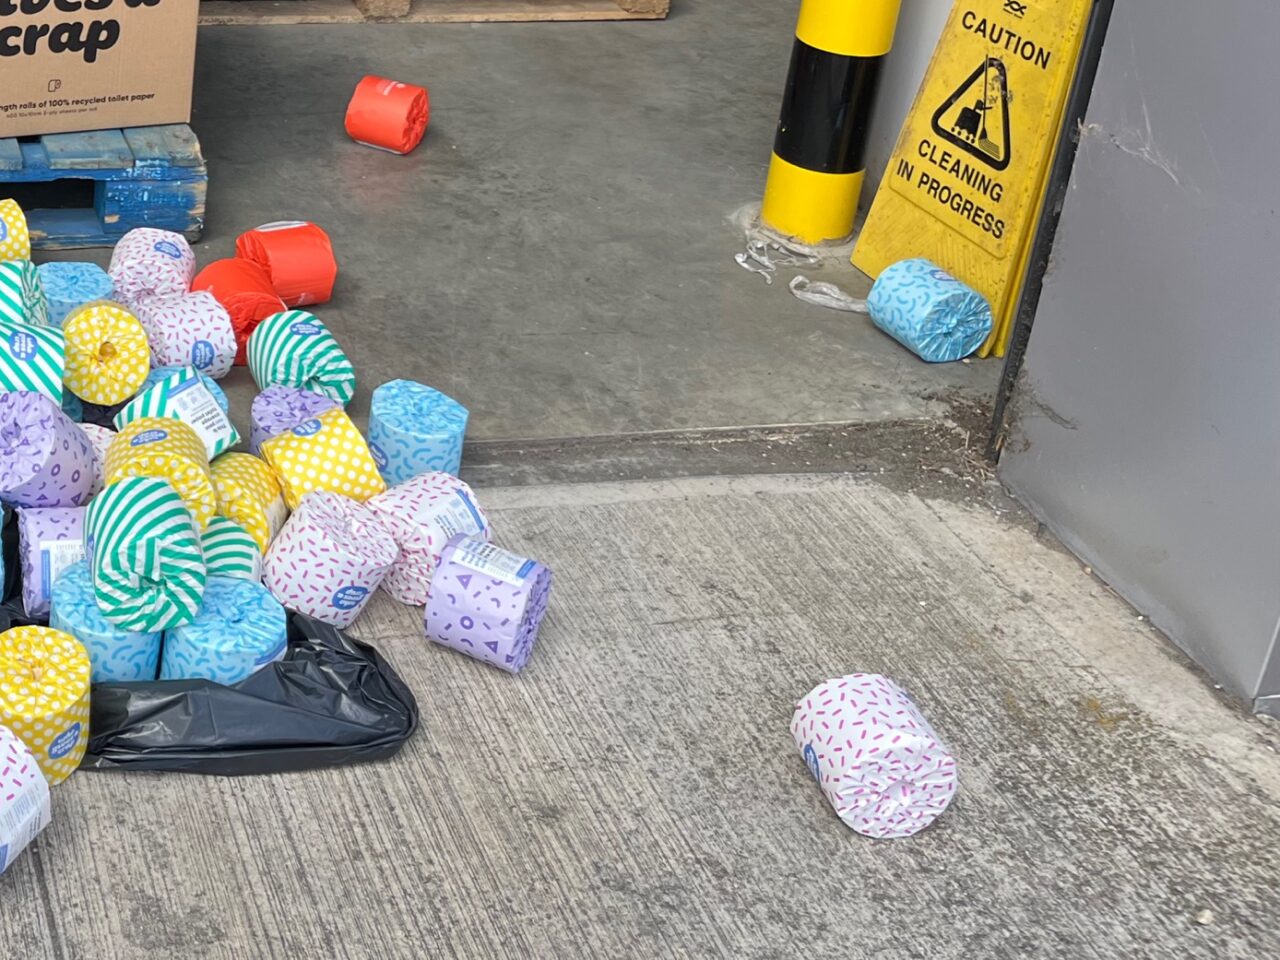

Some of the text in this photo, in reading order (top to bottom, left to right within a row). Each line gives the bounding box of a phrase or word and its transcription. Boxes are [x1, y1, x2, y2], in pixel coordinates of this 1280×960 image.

[962, 11, 1051, 69] CAUTION
[19, 102, 36, 110] rolls
[49, 99, 70, 107] 100%
[71, 96, 107, 106] recycled
[108, 95, 129, 103] toilet
[130, 93, 155, 102] paper
[897, 159, 1005, 239] IN PROGRESS
[918, 139, 1004, 203] CLEANING
